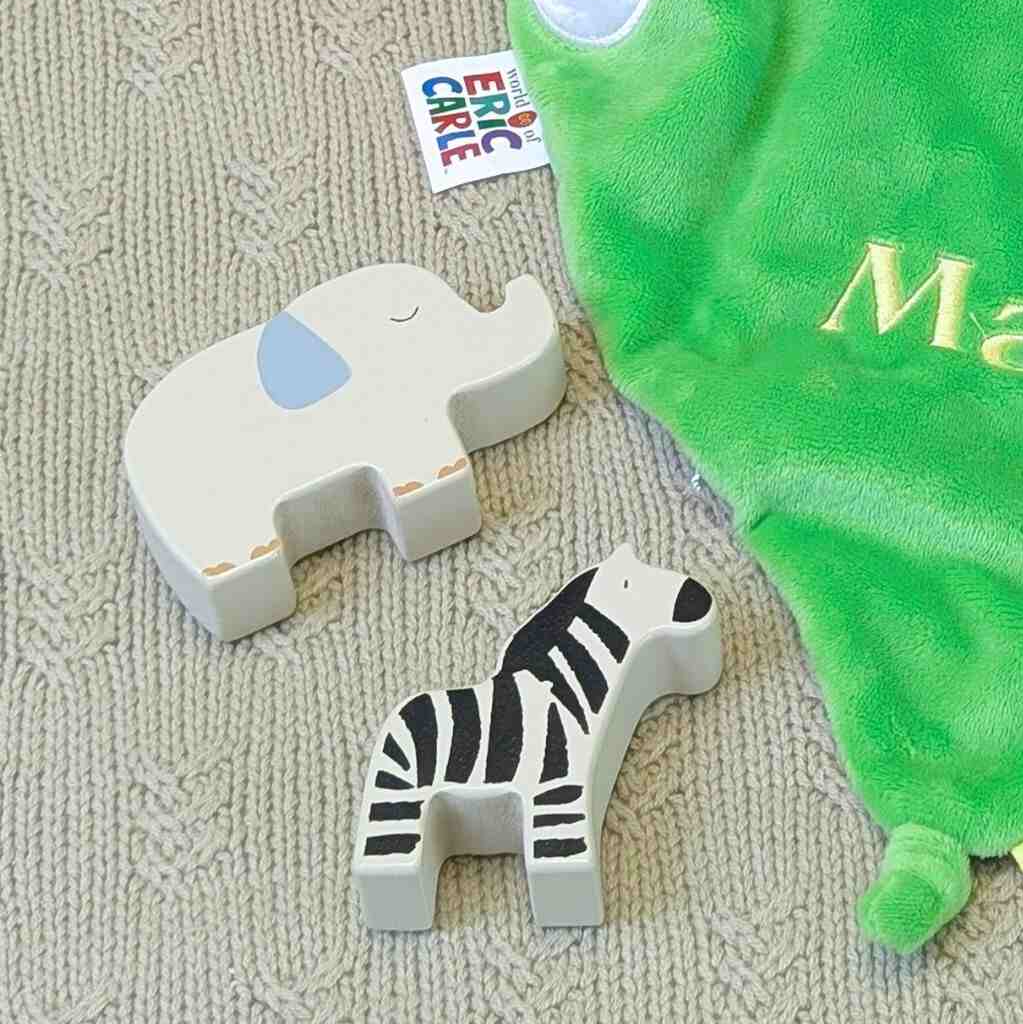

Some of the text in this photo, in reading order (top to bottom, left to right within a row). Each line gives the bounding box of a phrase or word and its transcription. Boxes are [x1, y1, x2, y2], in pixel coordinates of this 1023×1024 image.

[421, 76, 482, 167] CARLE
[463, 71, 522, 154] ERIC
[507, 68, 542, 144] world of
